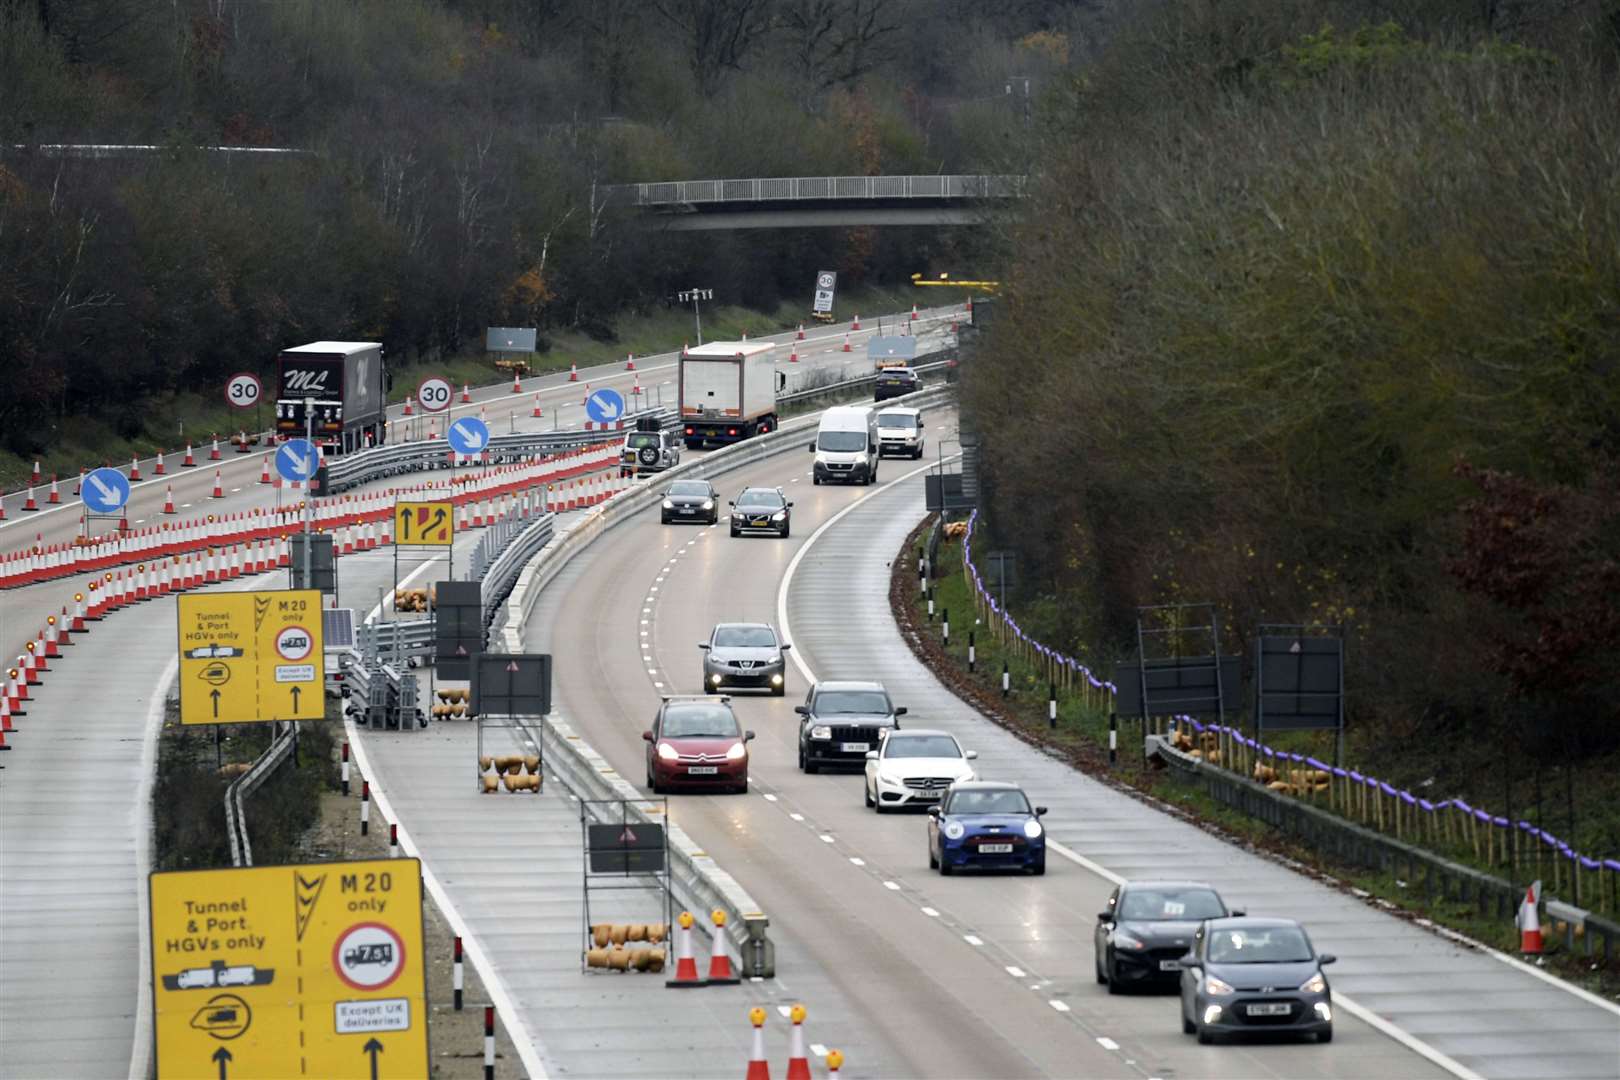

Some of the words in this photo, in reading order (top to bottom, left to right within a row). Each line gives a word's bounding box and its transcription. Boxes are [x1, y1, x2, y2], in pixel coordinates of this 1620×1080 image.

[232, 383, 257, 398] 30
[423, 387, 448, 401] 30
[197, 612, 230, 621] Tunnel
[282, 614, 303, 622] only
[207, 621, 229, 630] Port
[185, 632, 214, 640] HGVs
[217, 631, 239, 640] only
[184, 897, 247, 915] Tunnel
[347, 896, 386, 914] only
[187, 919, 198, 933] &
[207, 915, 246, 931] Port
[166, 936, 220, 953] HGVs
[226, 933, 265, 951] only
